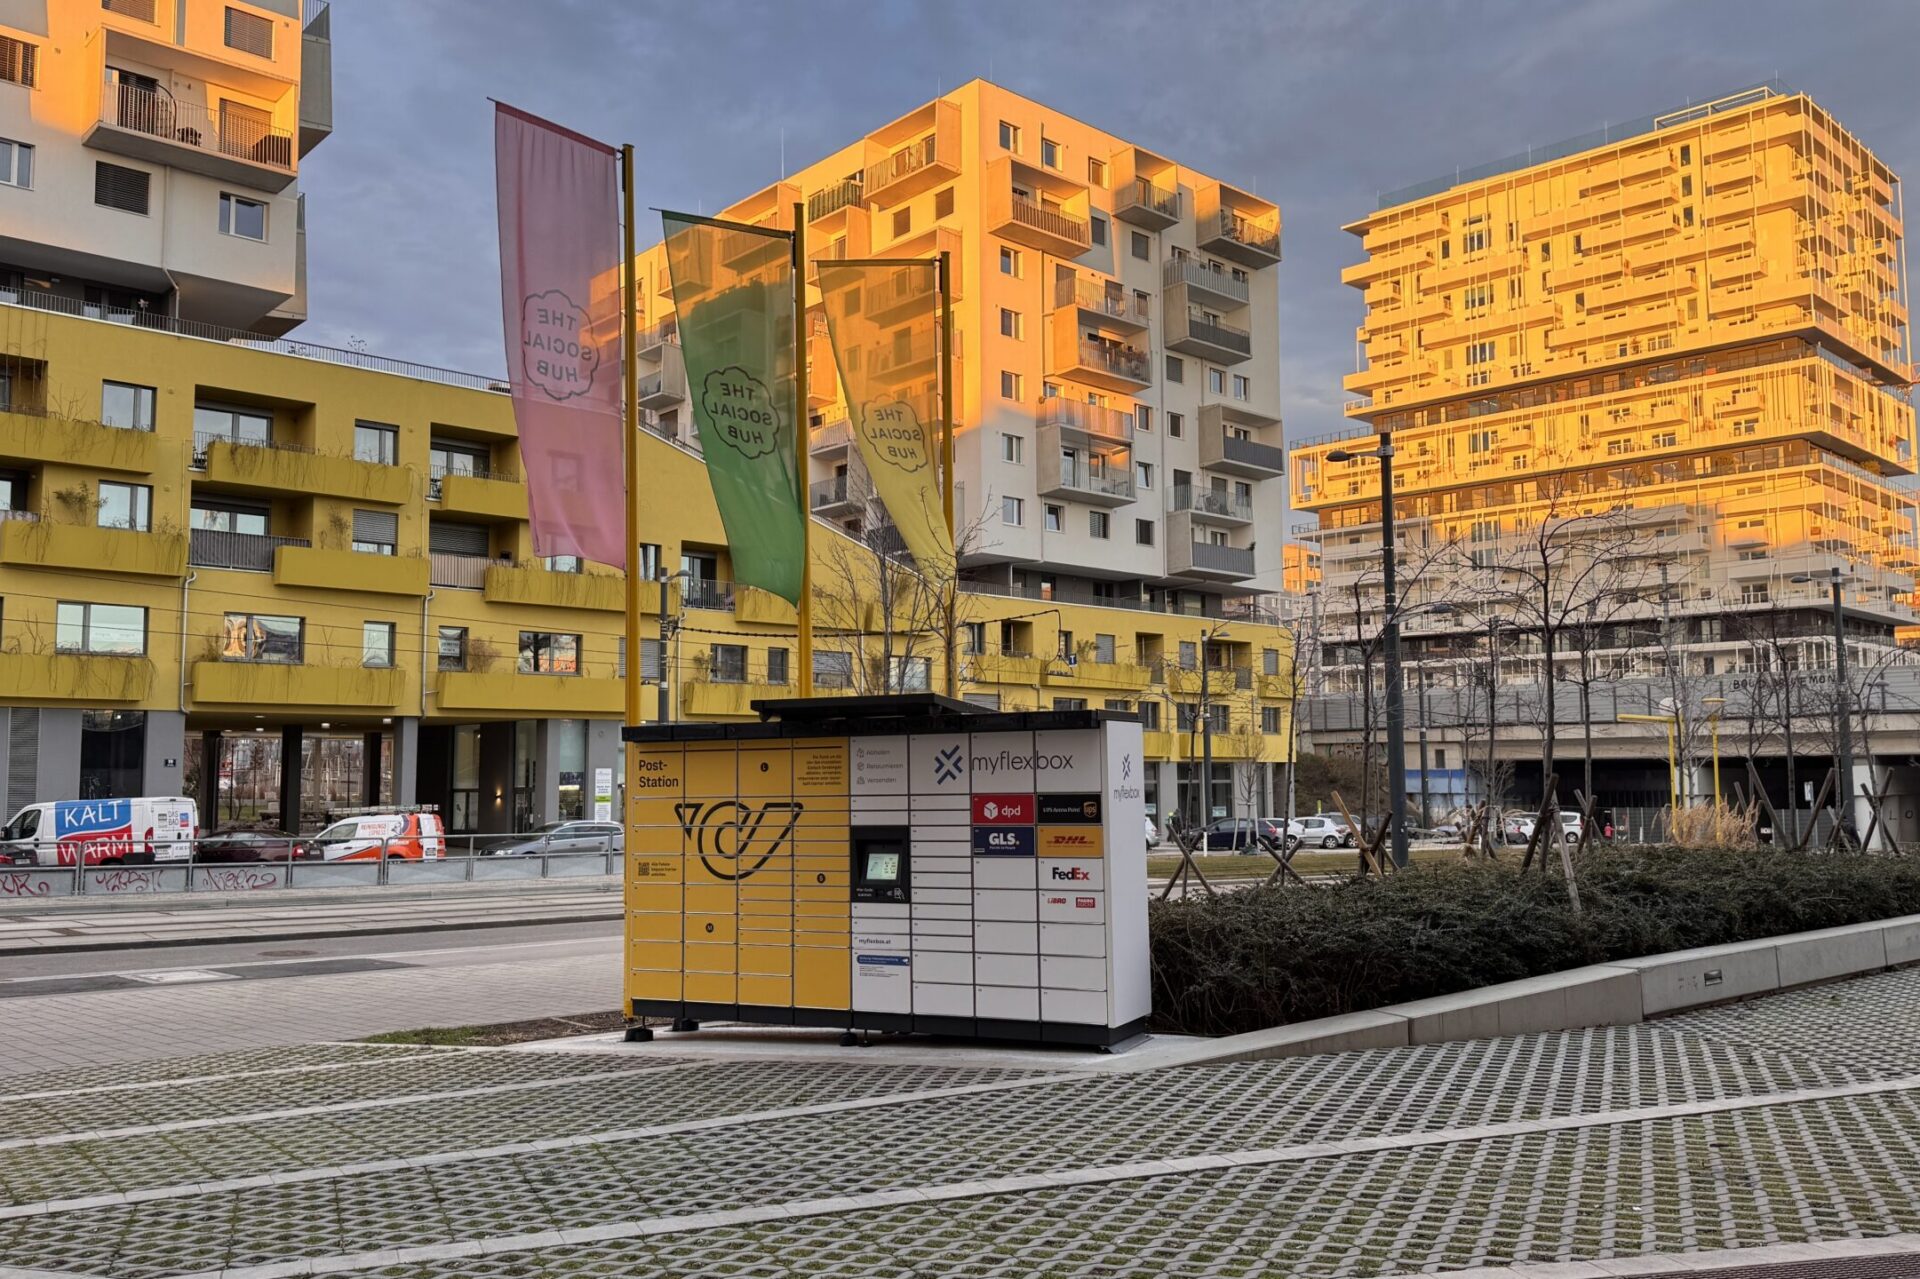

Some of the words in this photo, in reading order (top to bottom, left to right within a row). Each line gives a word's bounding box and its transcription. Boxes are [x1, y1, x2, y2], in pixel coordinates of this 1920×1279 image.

[638, 759, 668, 772] Post-
[971, 750, 1074, 775] myflexbox
[638, 776, 679, 788] Station
[64, 800, 125, 828] KALT
[1001, 805, 1021, 819] dpd
[1085, 805, 1097, 815] ups
[1053, 835, 1089, 845] DHL
[60, 833, 129, 863] WARM
[1052, 867, 1090, 881] FedEx
